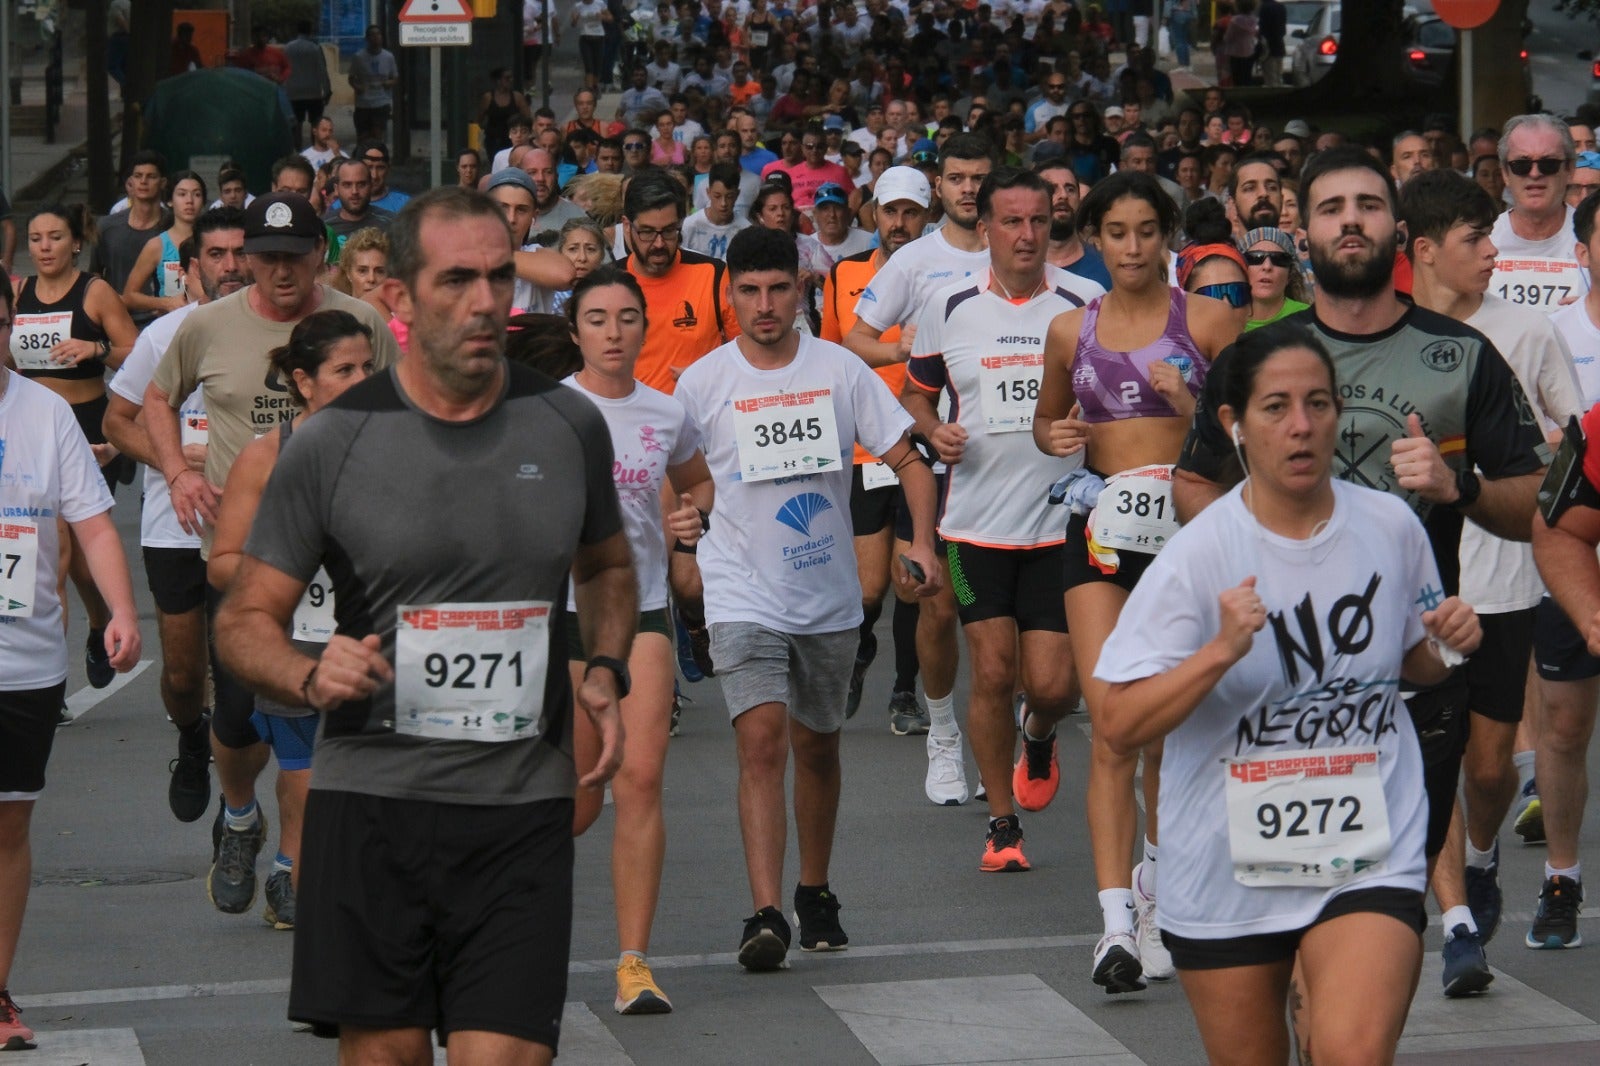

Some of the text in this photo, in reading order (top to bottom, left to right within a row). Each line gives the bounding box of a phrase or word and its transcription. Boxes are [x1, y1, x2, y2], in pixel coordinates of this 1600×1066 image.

[1498, 283, 1572, 306] 13977
[19, 331, 61, 350] 3826
[253, 394, 291, 409] Sierr
[996, 378, 1040, 402] 158
[1120, 380, 1142, 405] 2
[1339, 384, 1367, 399] OS
[1371, 387, 1384, 402] A
[250, 410, 275, 424] las
[734, 397, 759, 413] 42
[753, 417, 823, 448] 3845
[1116, 489, 1177, 522] 381
[782, 533, 834, 557] Fundación
[0, 553, 22, 579] 7
[793, 551, 832, 571] Unicaja
[403, 608, 439, 631] 42
[424, 650, 523, 689] 9271
[1230, 752, 1377, 784] 42 CARRERA URBANA
[1256, 795, 1364, 840] 9272
